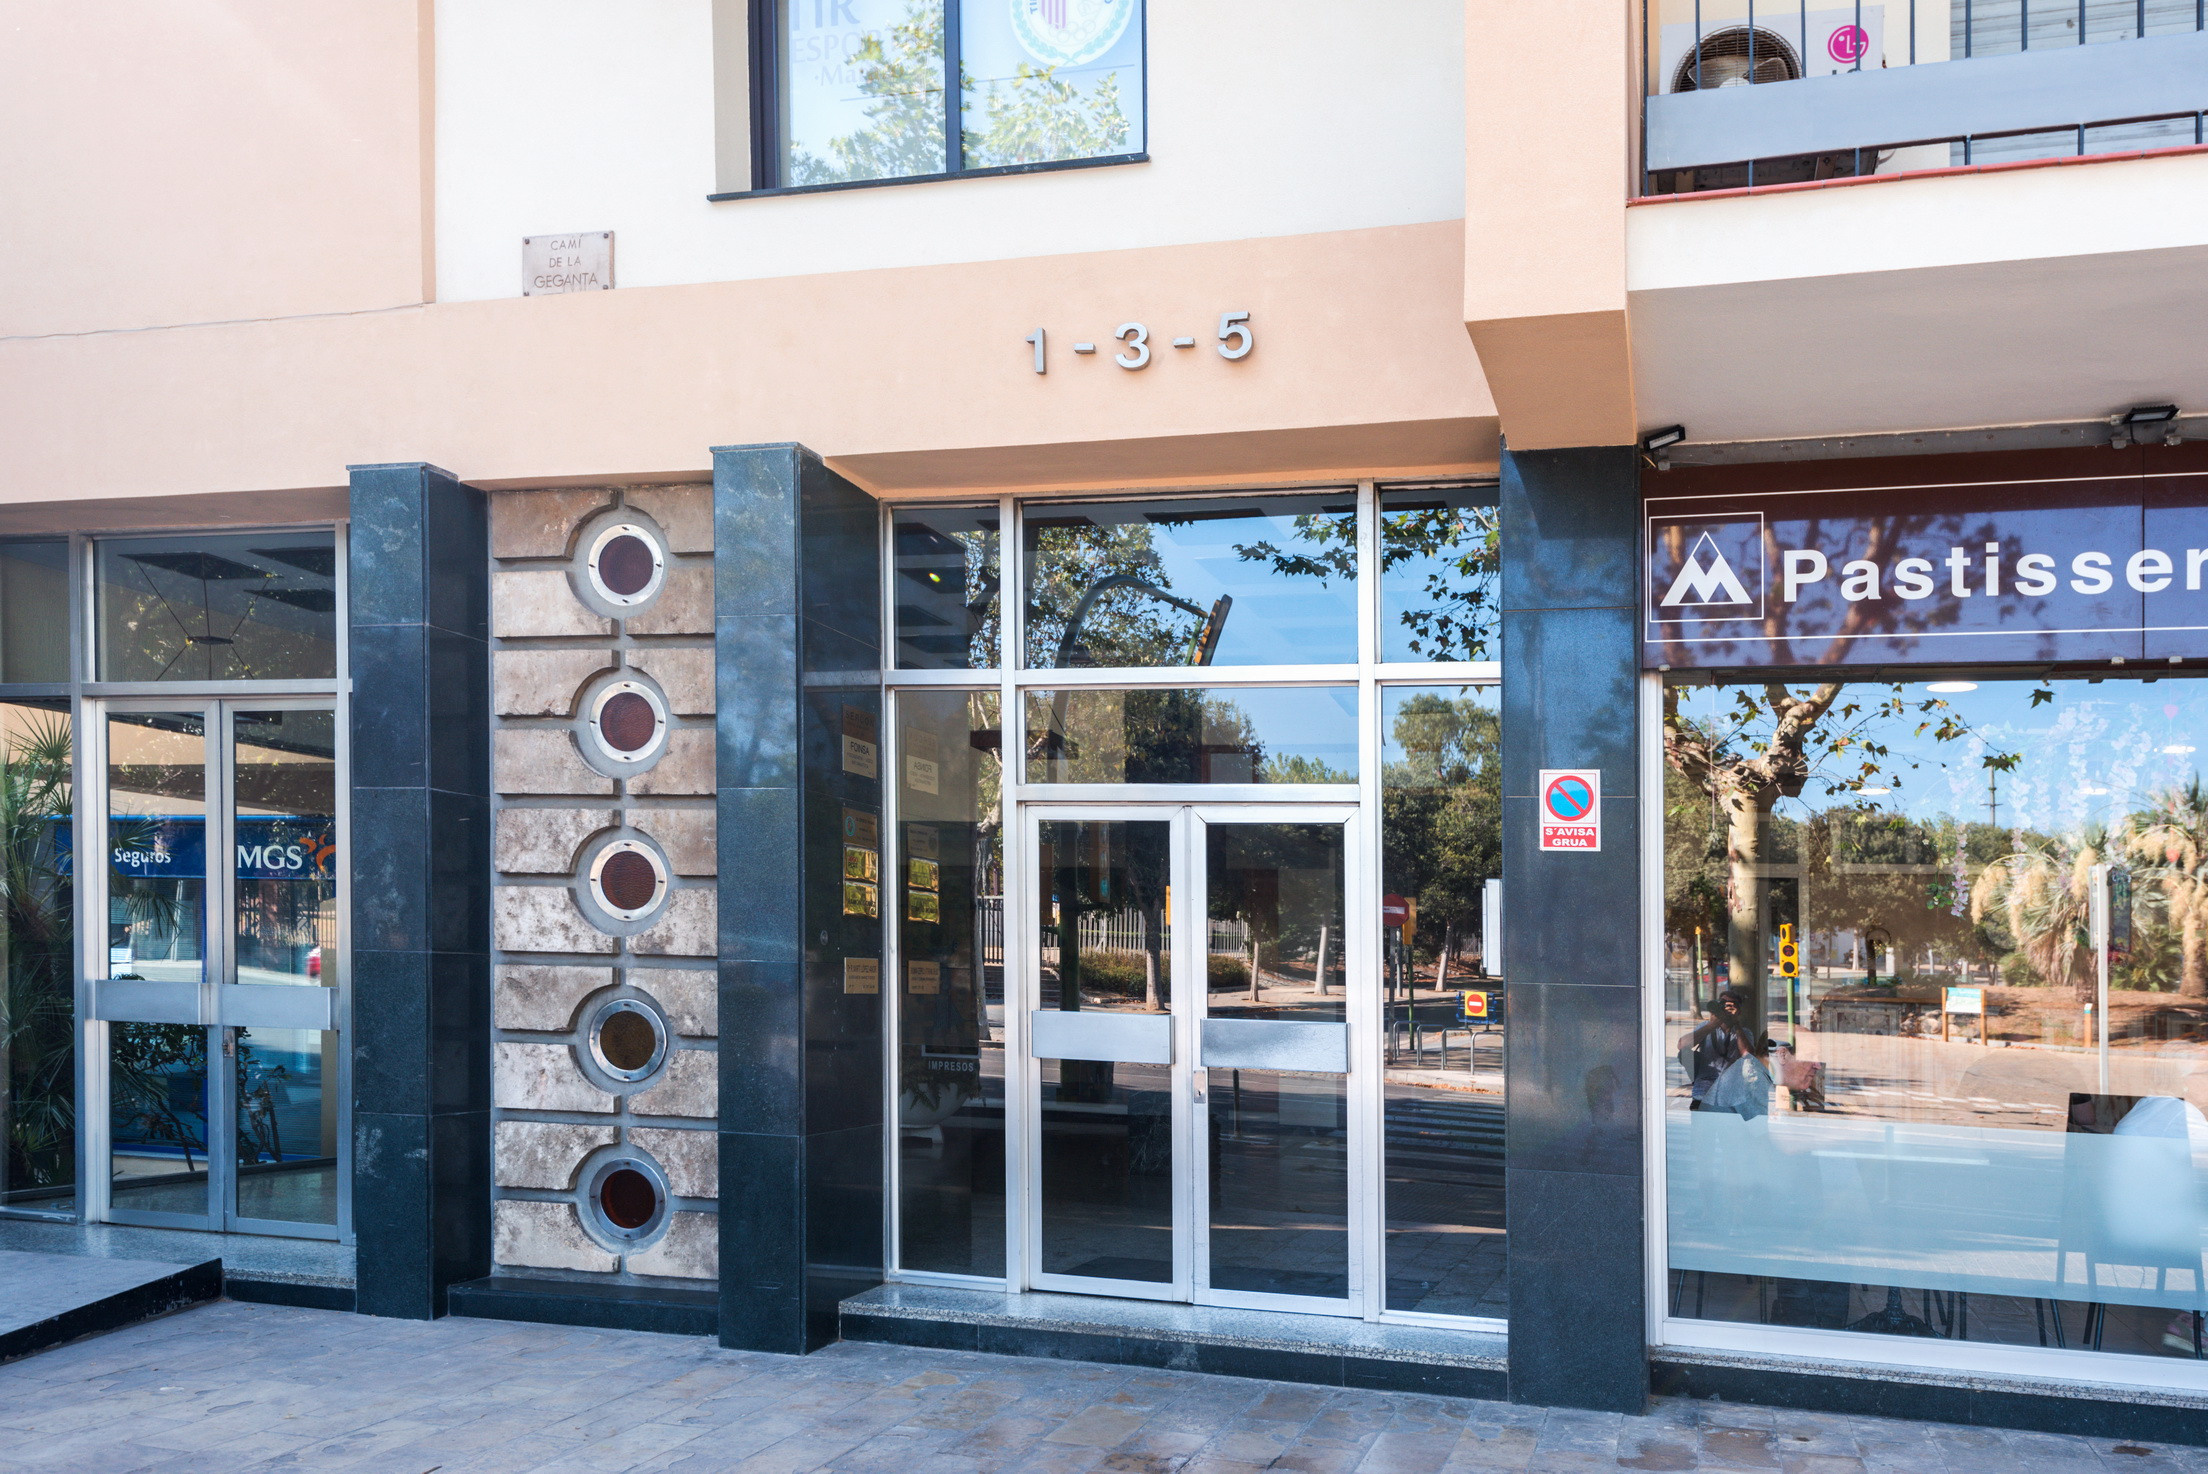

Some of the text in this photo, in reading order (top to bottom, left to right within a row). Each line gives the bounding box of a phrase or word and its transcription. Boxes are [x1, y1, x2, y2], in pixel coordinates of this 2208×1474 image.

[550, 233, 584, 251] CAMÍ
[549, 256, 582, 268] DE LA
[533, 272, 598, 288] GEGANTA
[1783, 541, 2208, 603] Pastisser
[1552, 838, 1588, 847] GRUA
[114, 844, 303, 870] Seguros MGS
[928, 1060, 974, 1072] IMPRESOS
